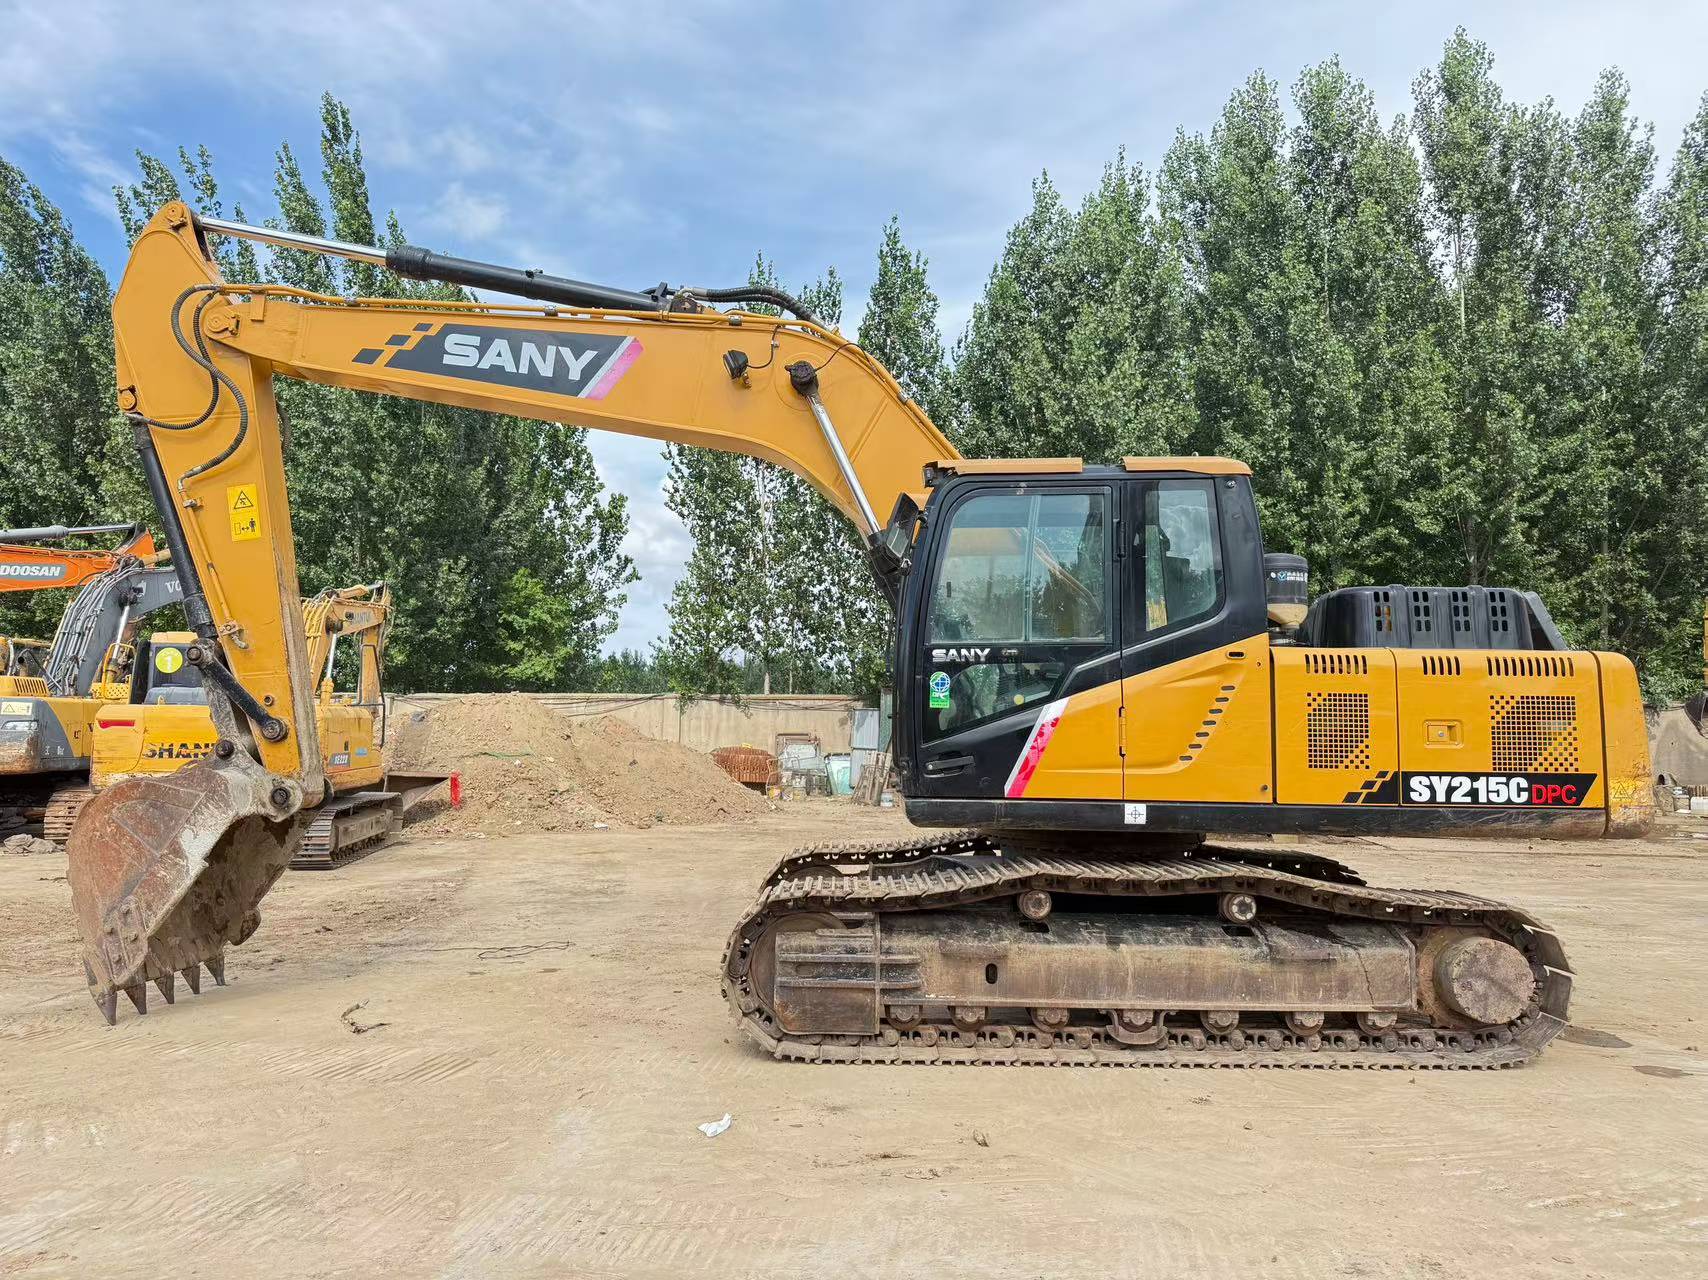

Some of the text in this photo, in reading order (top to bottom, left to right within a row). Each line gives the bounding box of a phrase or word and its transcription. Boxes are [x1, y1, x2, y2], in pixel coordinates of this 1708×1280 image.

[443, 333, 599, 381] SANY
[0, 564, 61, 577] DOOSAN
[932, 648, 991, 662] SANY
[143, 742, 215, 759] SHAN
[1409, 776, 1577, 805] SY215C DPC
